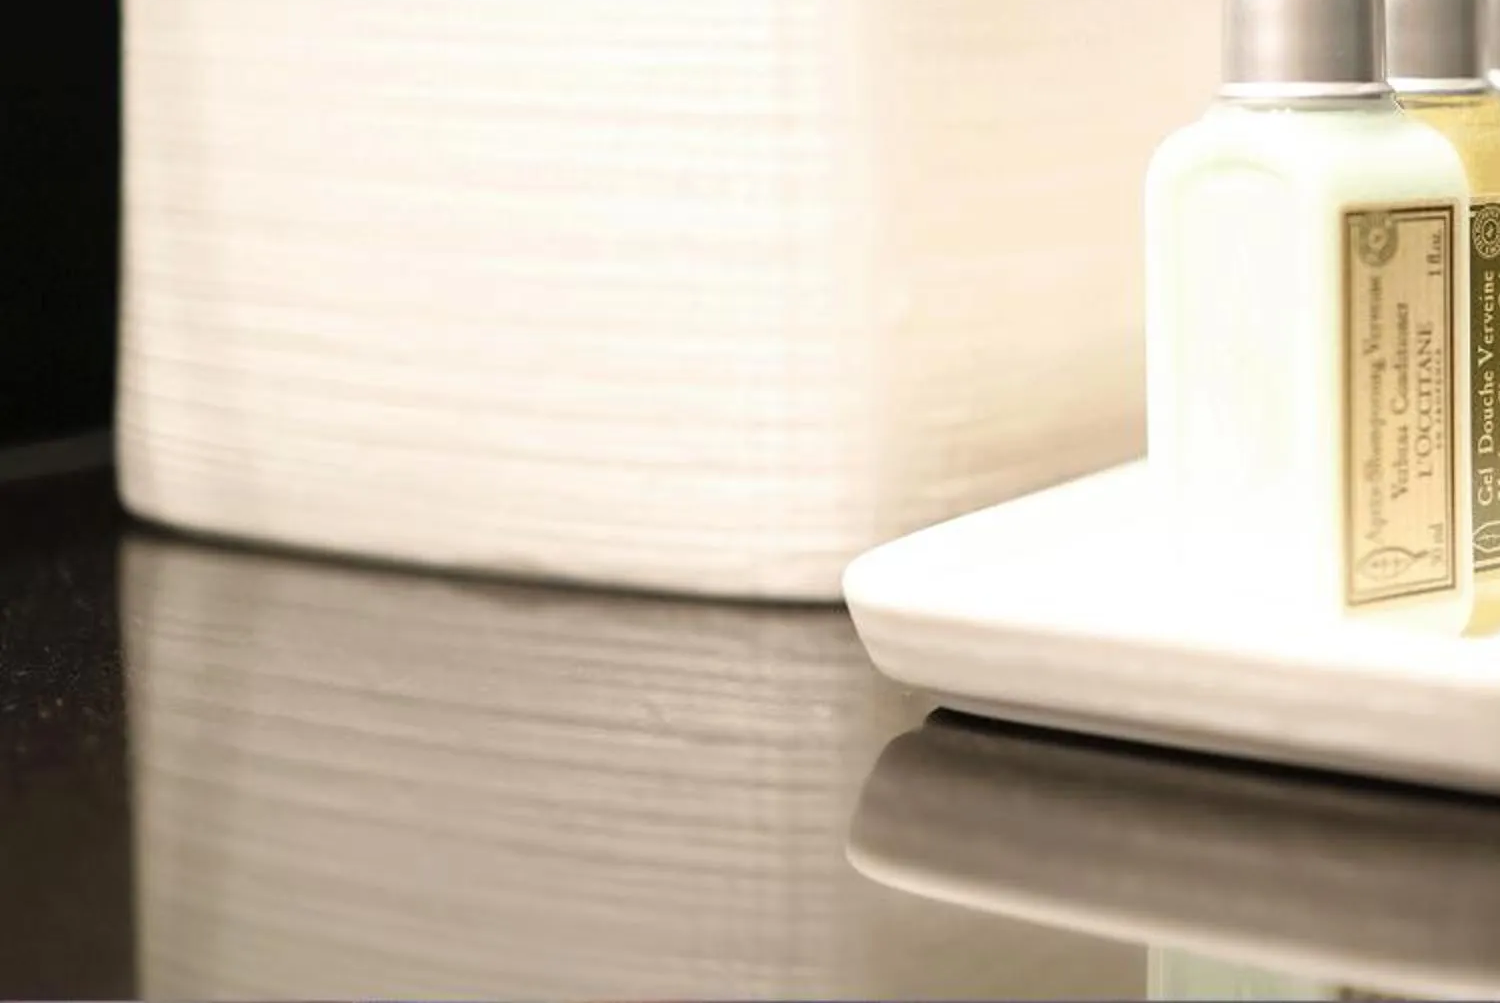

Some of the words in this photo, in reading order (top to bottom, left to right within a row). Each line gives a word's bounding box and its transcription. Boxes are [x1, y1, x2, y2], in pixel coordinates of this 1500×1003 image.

[1477, 270, 1495, 368] Verveine
[1415, 322, 1434, 478] L'OCCITANE
[1478, 371, 1495, 454] Douche
[1477, 468, 1494, 506] Gel
